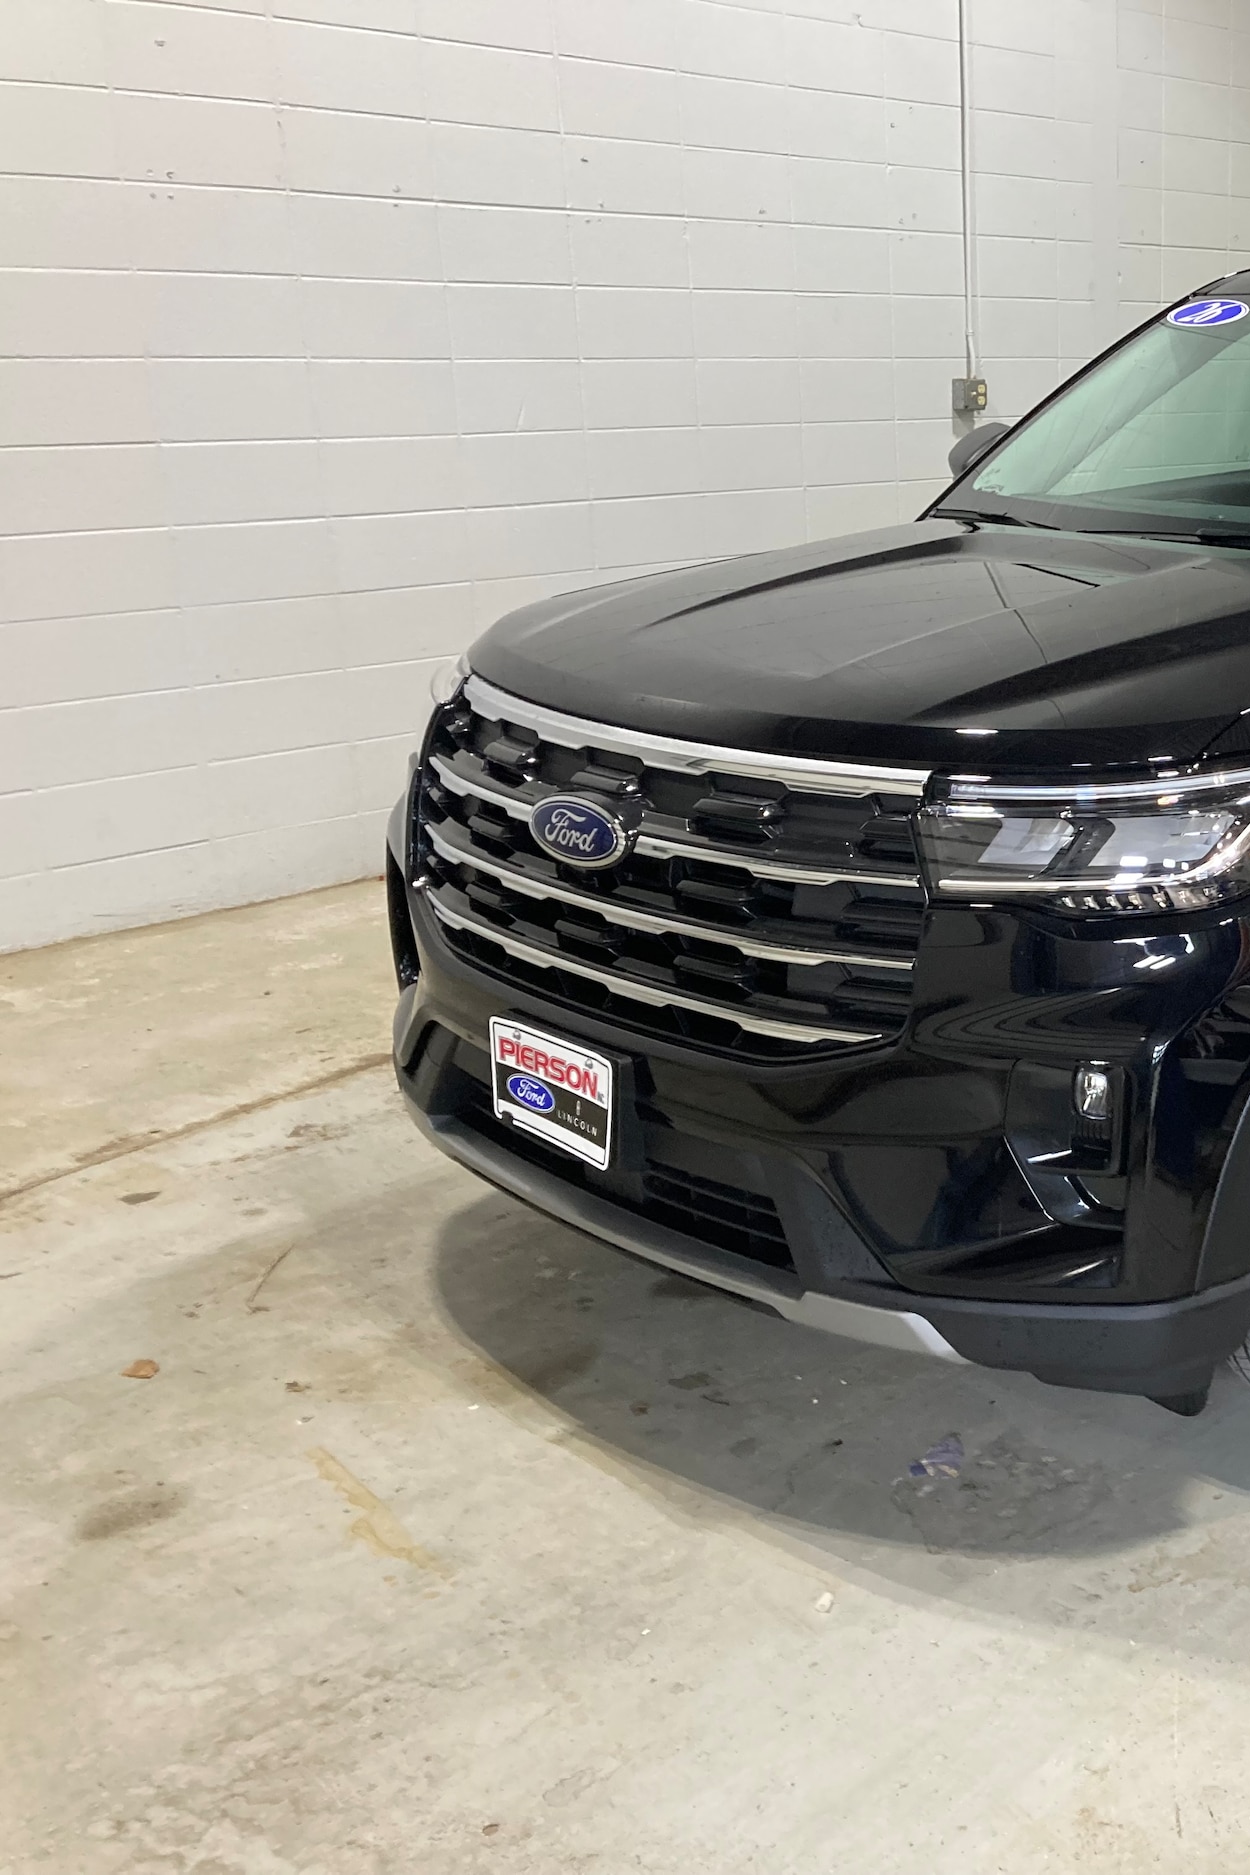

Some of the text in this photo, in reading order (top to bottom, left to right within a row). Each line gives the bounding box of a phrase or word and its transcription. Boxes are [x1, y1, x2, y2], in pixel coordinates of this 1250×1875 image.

[545, 808, 598, 853] Ford
[498, 1035, 598, 1100] PIERSON
[517, 1079, 546, 1107] Ford
[557, 1109, 598, 1137] LINCOLN
